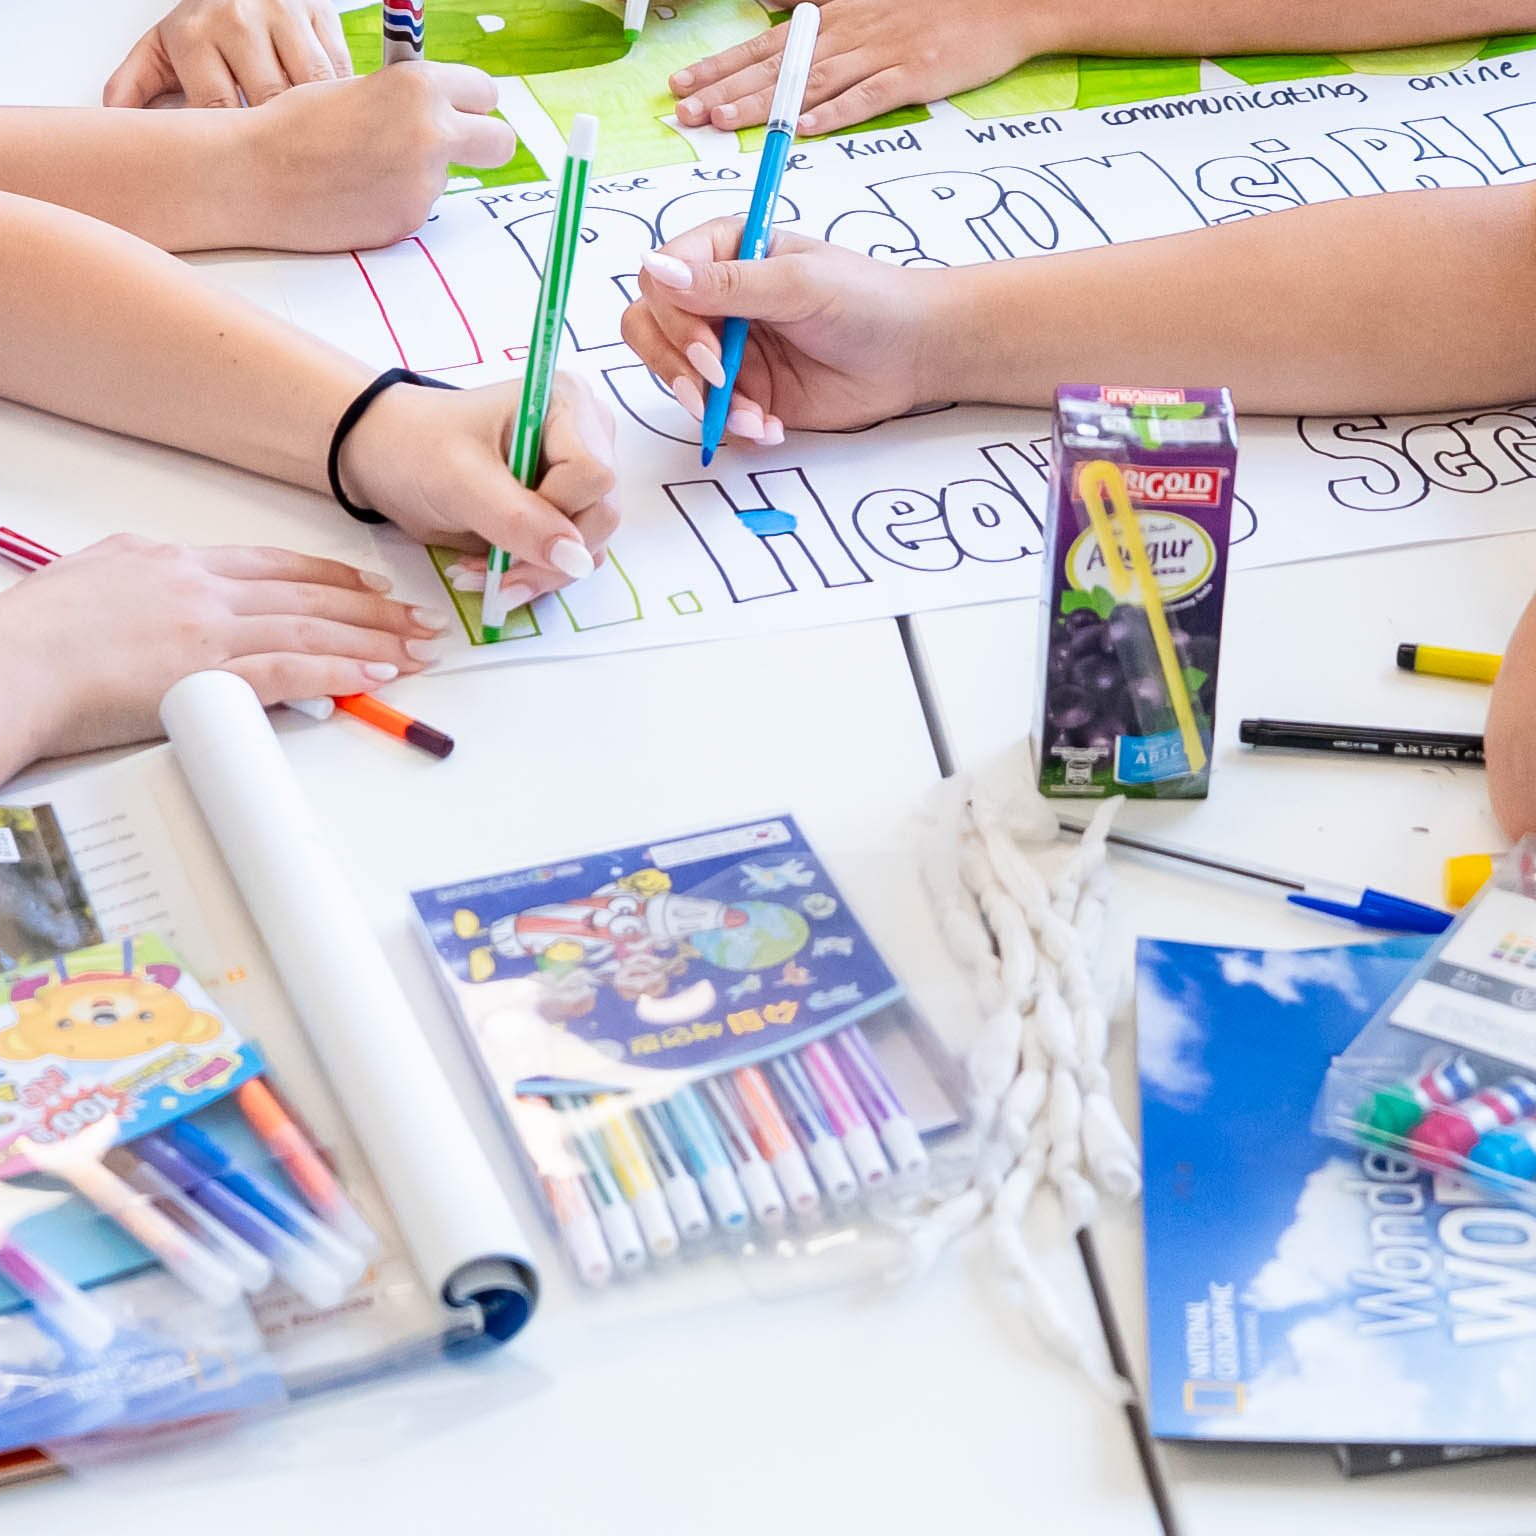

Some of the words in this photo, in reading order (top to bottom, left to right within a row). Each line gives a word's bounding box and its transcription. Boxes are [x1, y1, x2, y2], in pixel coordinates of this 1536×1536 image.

[692, 165, 742, 183] to
[1100, 78, 1370, 128] communicating
[1407, 56, 1521, 94] online
